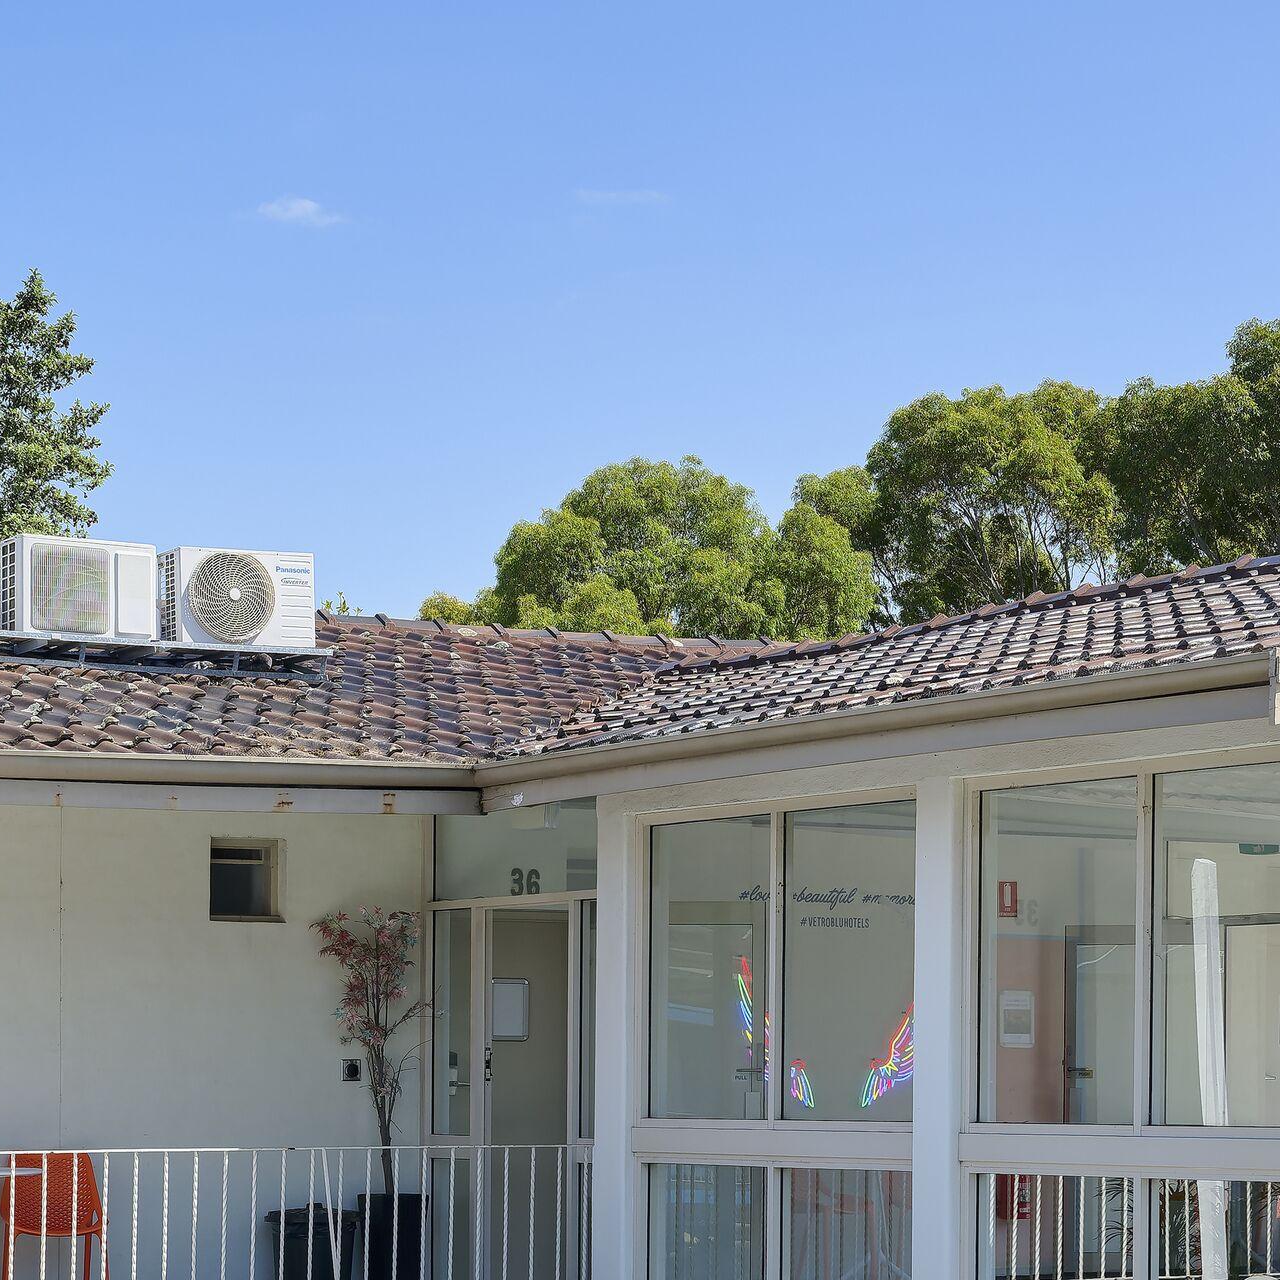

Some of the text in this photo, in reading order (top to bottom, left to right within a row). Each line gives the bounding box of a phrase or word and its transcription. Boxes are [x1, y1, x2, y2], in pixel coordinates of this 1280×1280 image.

[275, 565, 311, 574] Panasonic
[510, 867, 540, 896] 36
[738, 885, 770, 901] #lov
[800, 916, 870, 929] #VETROBLUHOTELS
